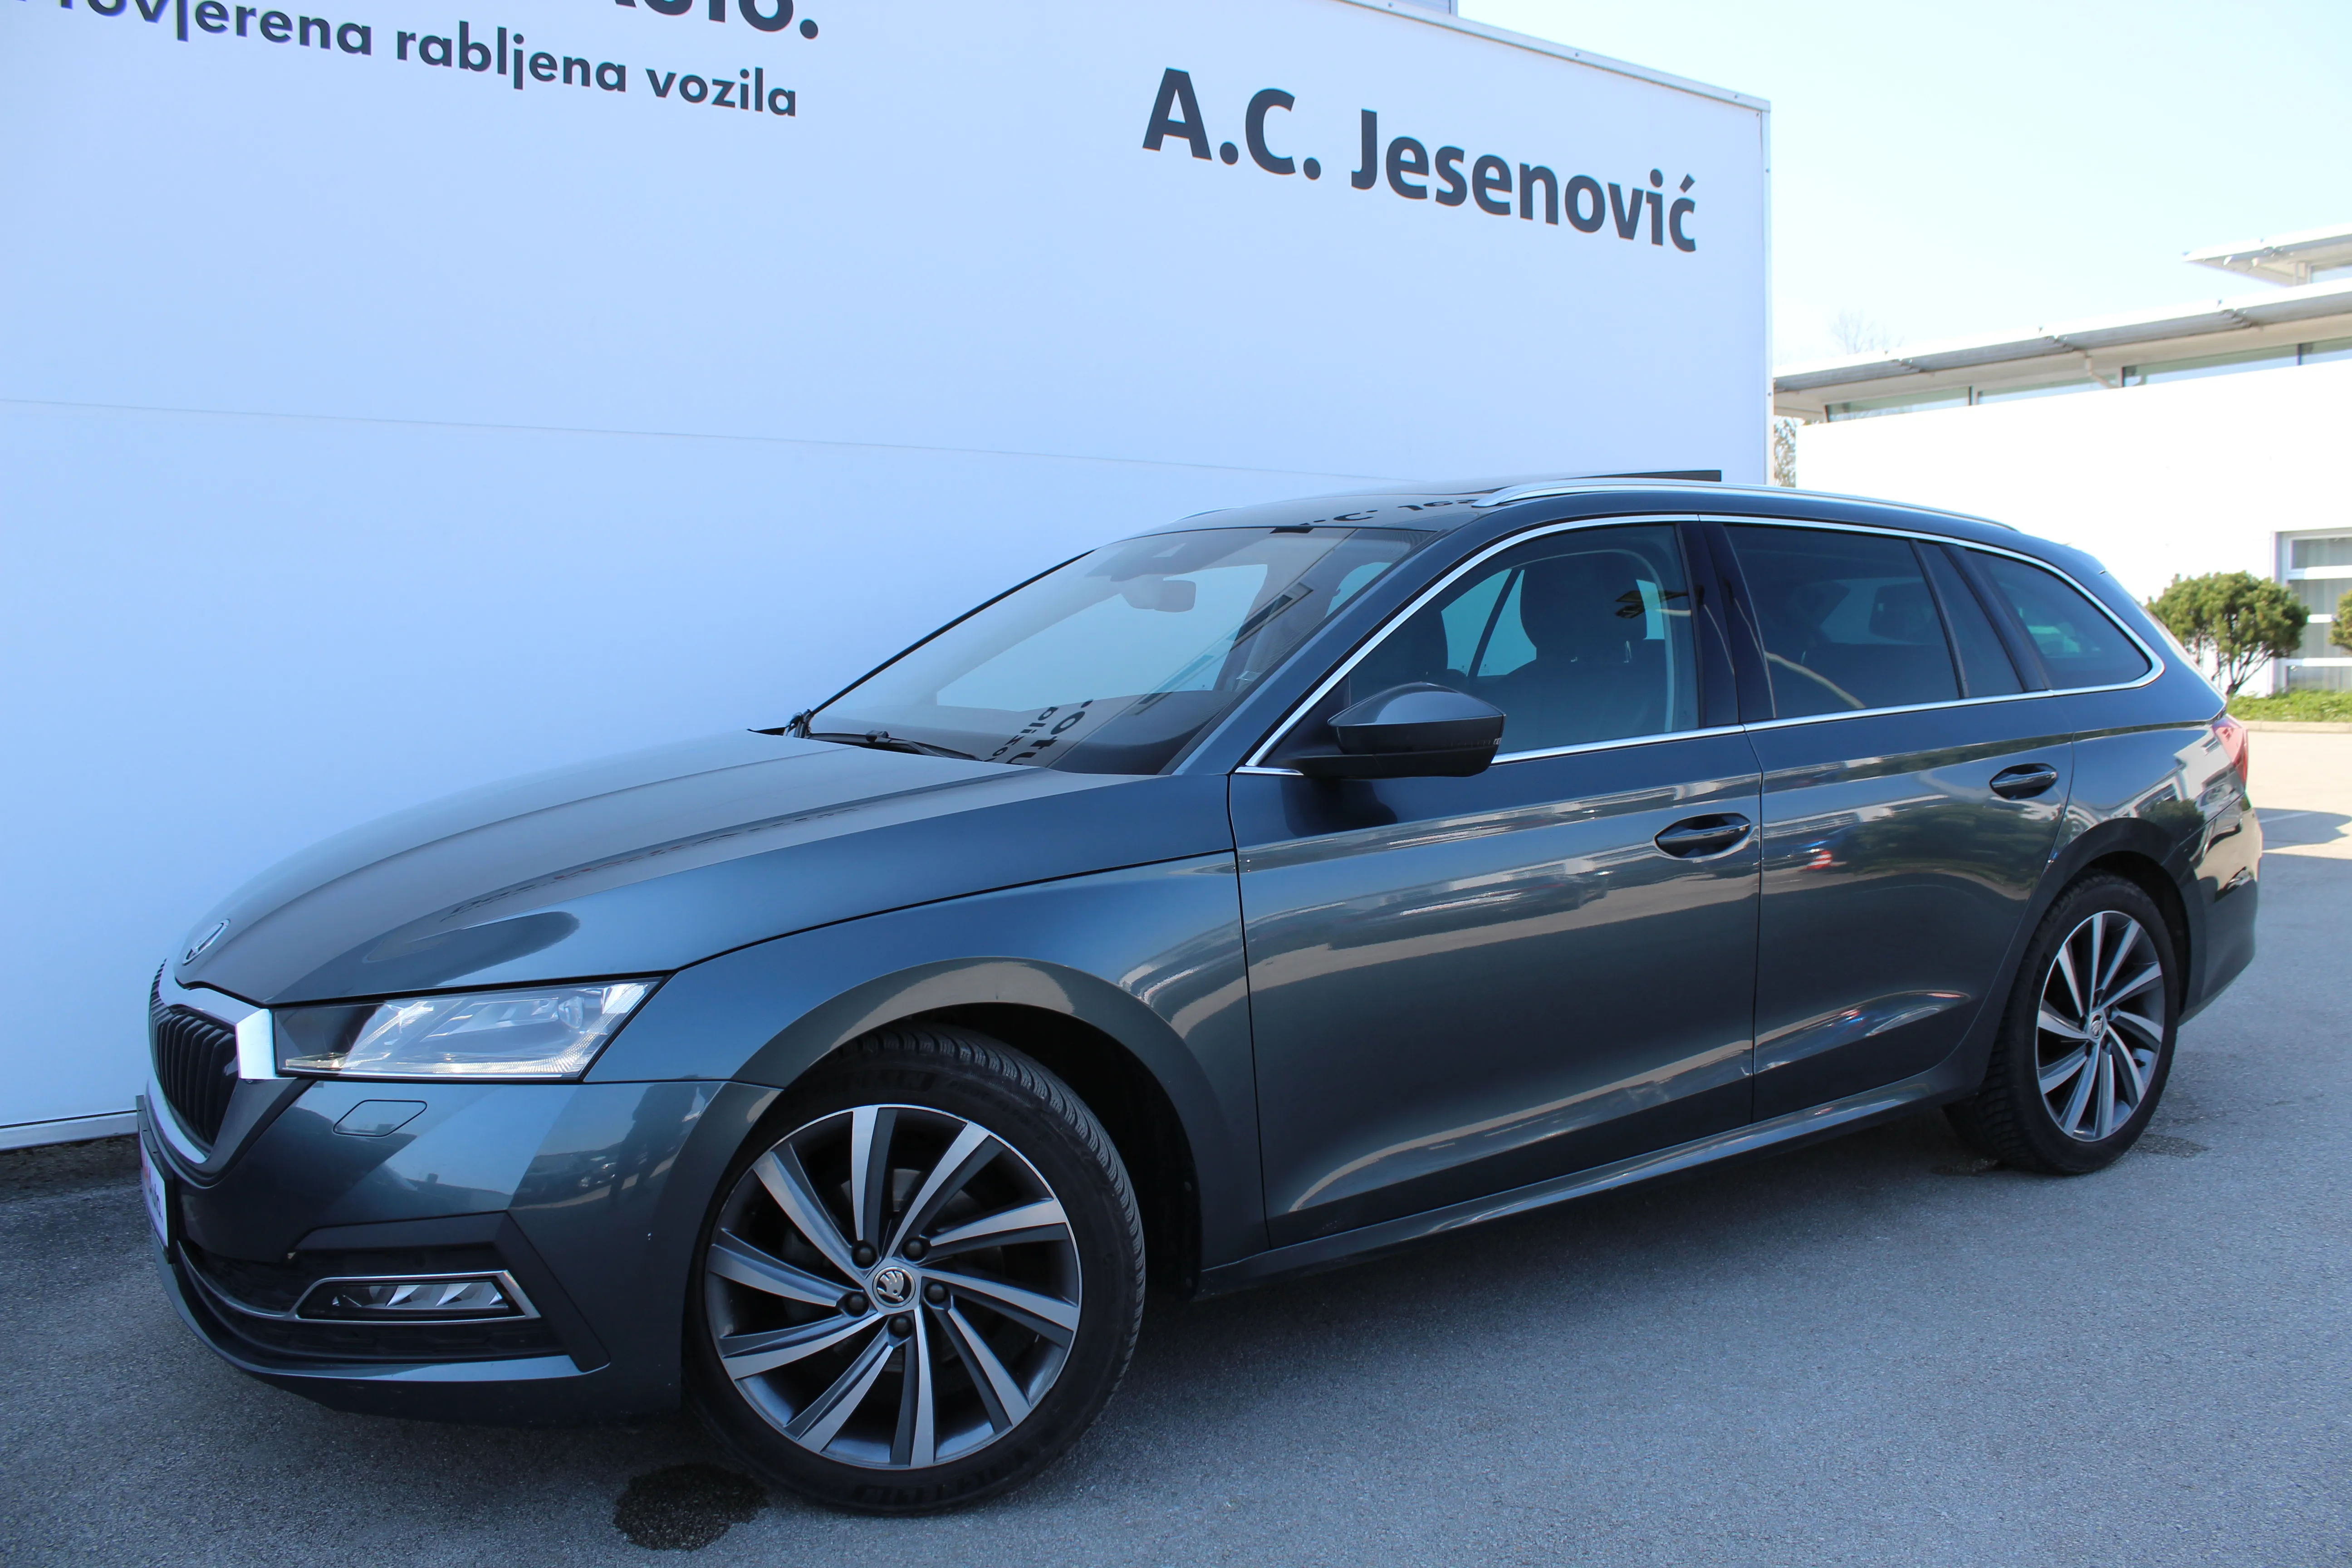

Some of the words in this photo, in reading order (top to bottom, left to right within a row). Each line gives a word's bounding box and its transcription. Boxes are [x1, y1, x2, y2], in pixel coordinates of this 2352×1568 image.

[397, 20, 627, 93] rabljena
[645, 67, 796, 117] vozila
[1142, 67, 1321, 180] A.C.
[1351, 109, 1696, 253] Jesenović
